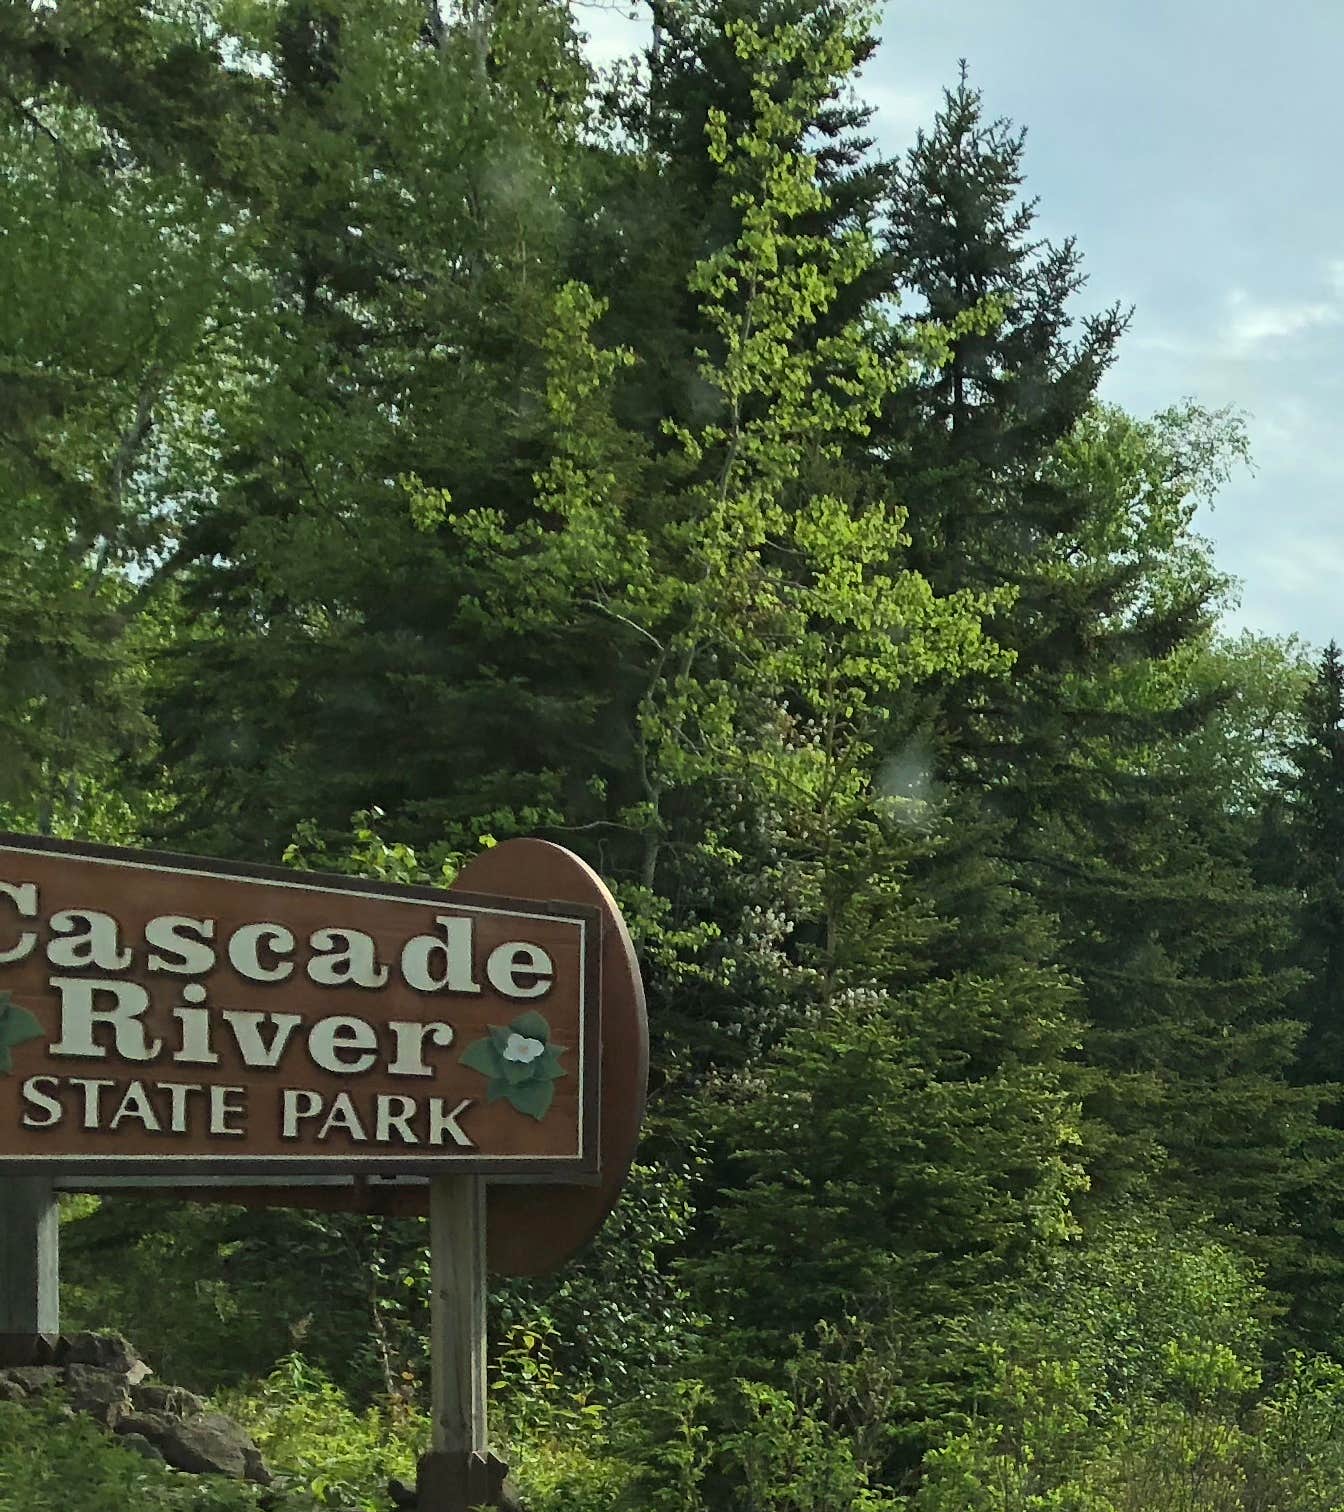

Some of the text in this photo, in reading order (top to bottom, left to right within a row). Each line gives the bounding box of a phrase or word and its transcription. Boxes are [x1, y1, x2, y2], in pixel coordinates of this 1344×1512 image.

[49, 976, 453, 1077] River
[22, 1075, 475, 1147] STATE PARK
